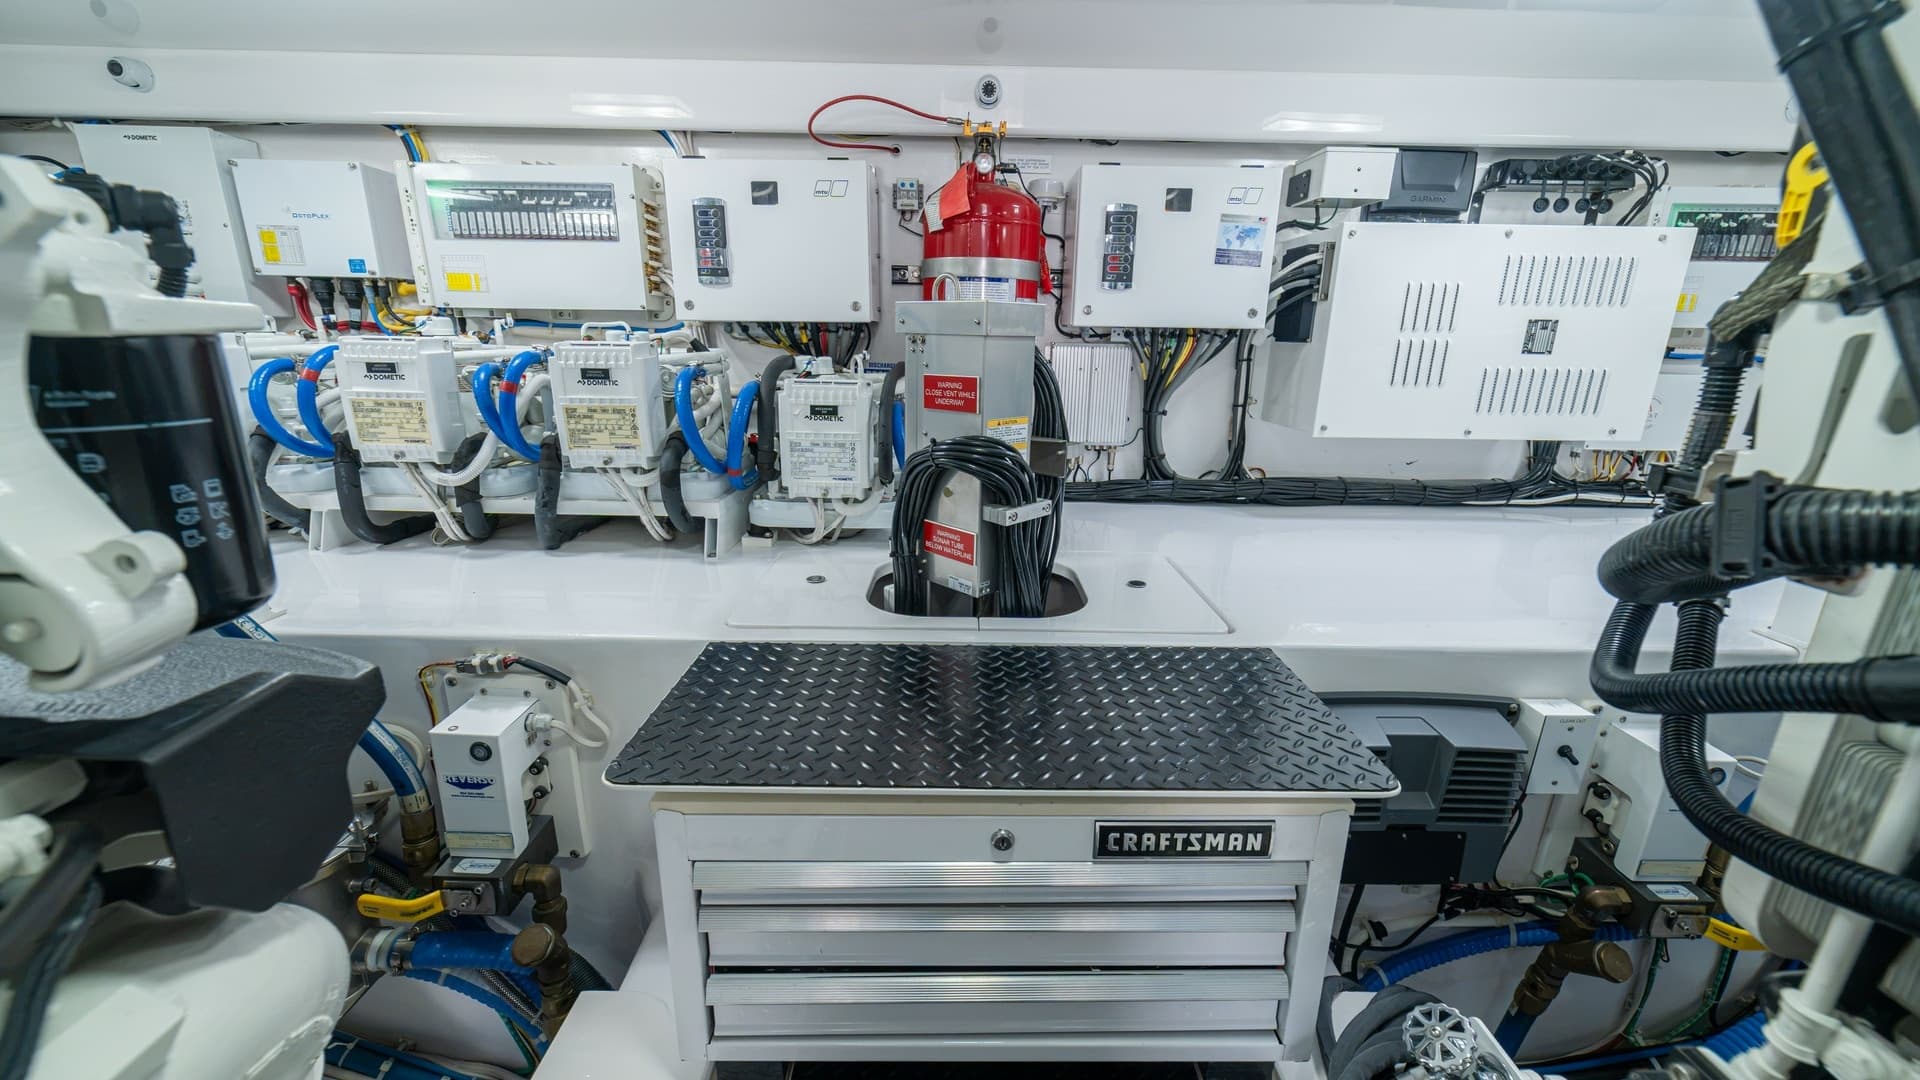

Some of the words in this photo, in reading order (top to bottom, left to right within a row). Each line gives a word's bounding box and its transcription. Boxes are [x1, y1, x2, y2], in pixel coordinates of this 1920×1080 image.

[937, 381, 963, 390] WARNING
[925, 388, 943, 397] CLOSE
[957, 391, 977, 399] WHILE
[935, 398, 965, 407] UNDERWAY
[933, 535, 950, 546] SONAR
[951, 540, 965, 551] TUBE
[925, 540, 943, 551] BELOW
[943, 545, 972, 560] WATERLINE
[442, 776, 496, 785] REVERSO
[1107, 832, 1263, 851] CRAFTSMAN
